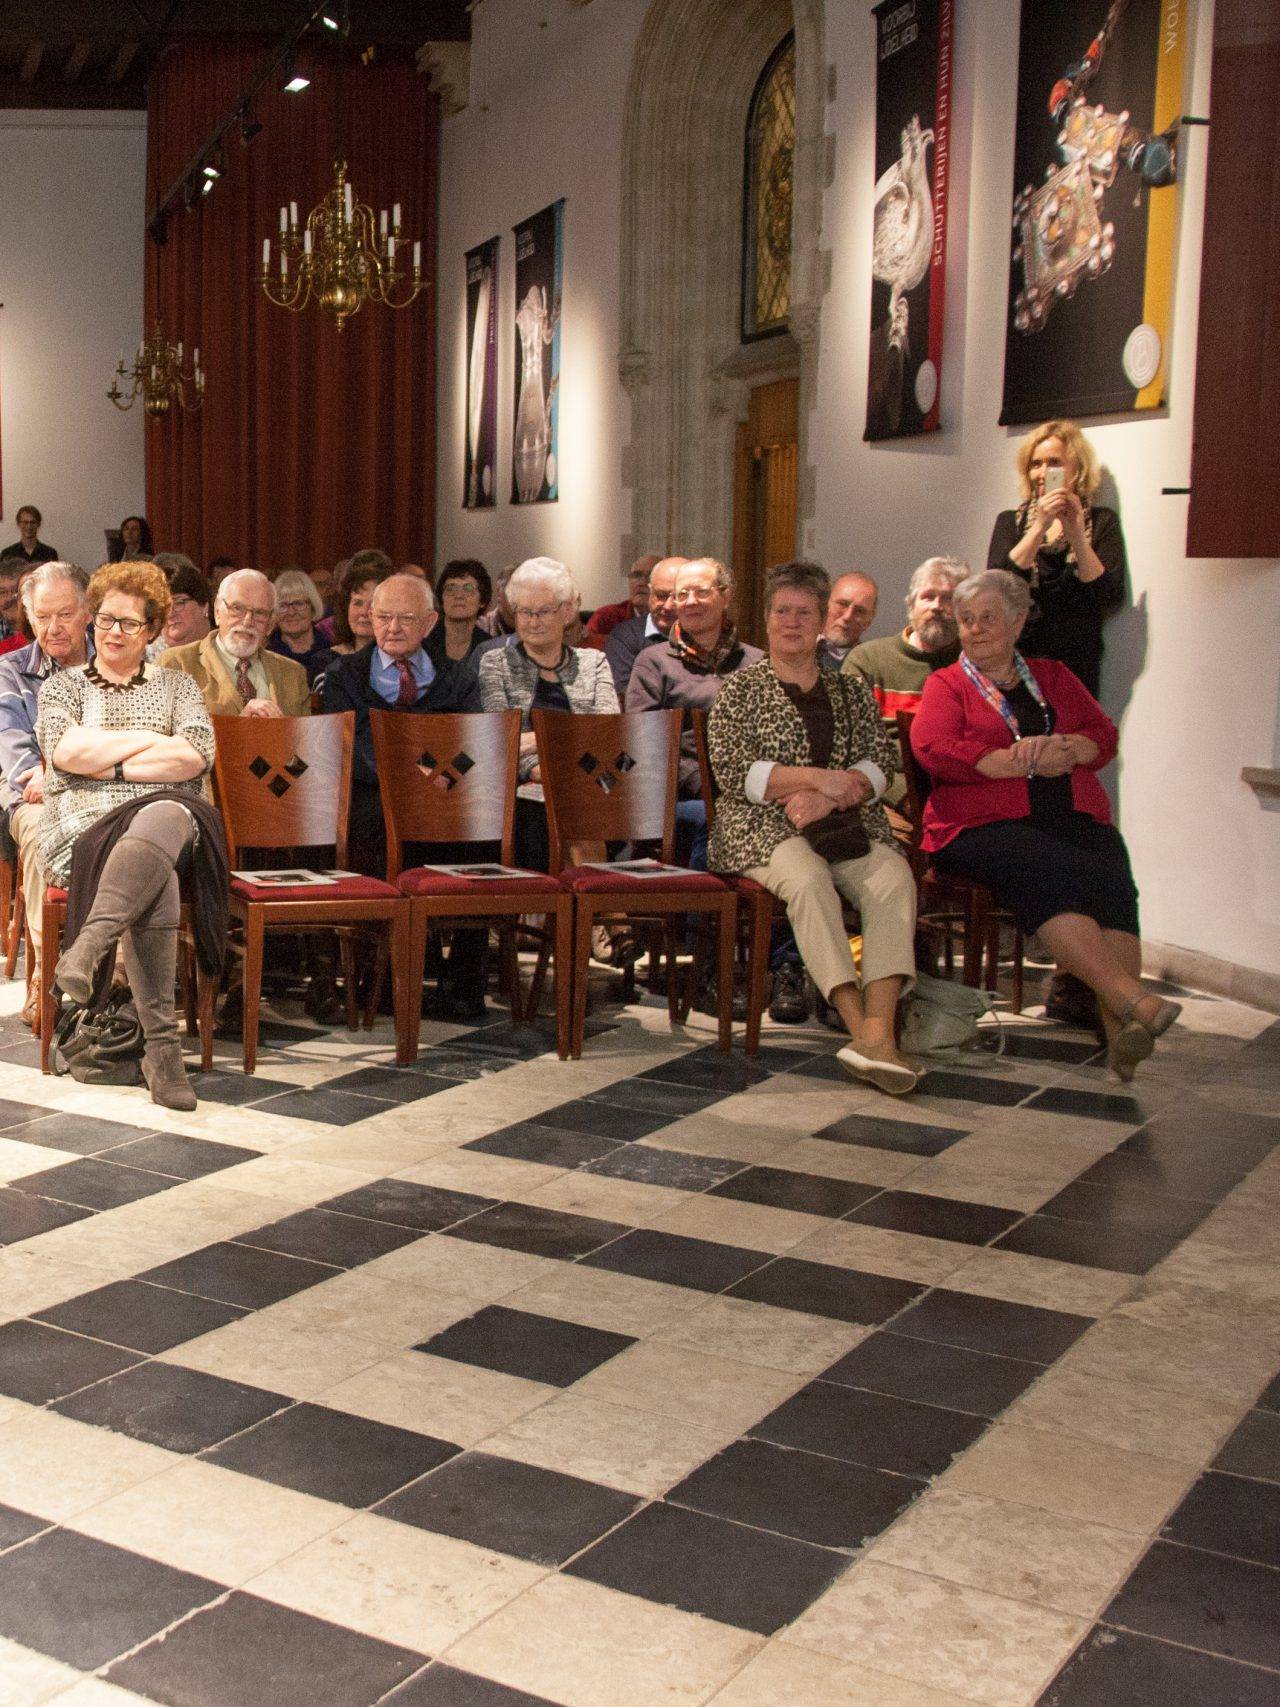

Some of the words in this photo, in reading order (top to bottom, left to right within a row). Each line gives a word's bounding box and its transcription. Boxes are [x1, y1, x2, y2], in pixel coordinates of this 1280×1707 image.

[939, 45, 949, 90] HUN
[938, 94, 948, 121] EN
[934, 126, 947, 267] SCHUTTERIJEN
